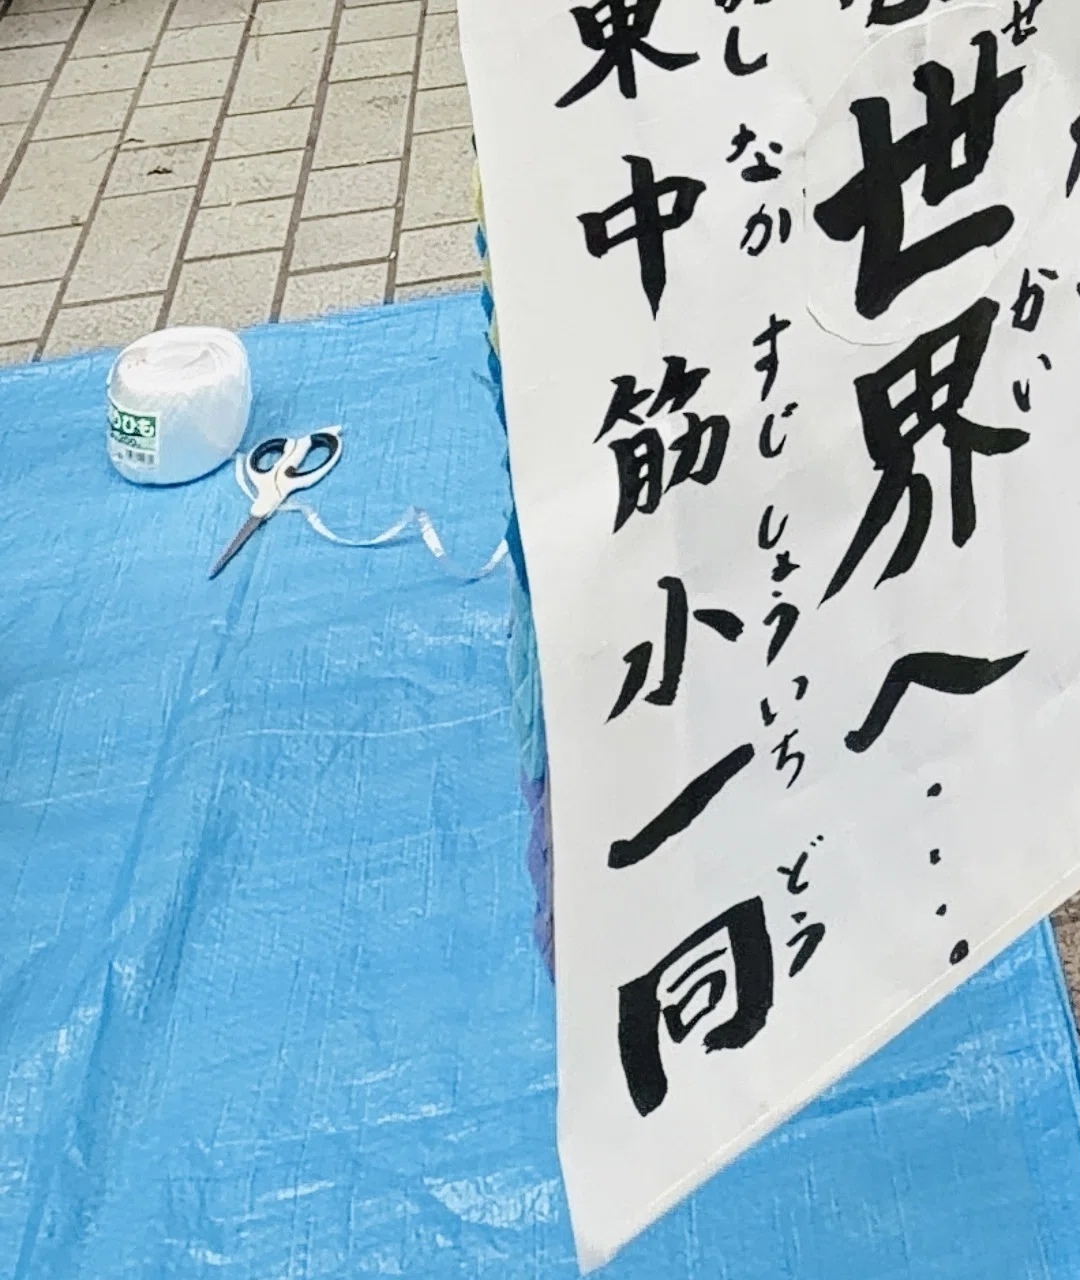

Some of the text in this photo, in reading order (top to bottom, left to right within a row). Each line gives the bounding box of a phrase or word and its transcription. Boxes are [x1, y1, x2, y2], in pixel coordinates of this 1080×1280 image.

[726, 124, 791, 256] なか
[753, 314, 798, 458] すじ
[1011, 268, 1058, 412] かい
[759, 506, 800, 665] しょう
[761, 676, 808, 788] いち
[777, 836, 825, 977] どう
